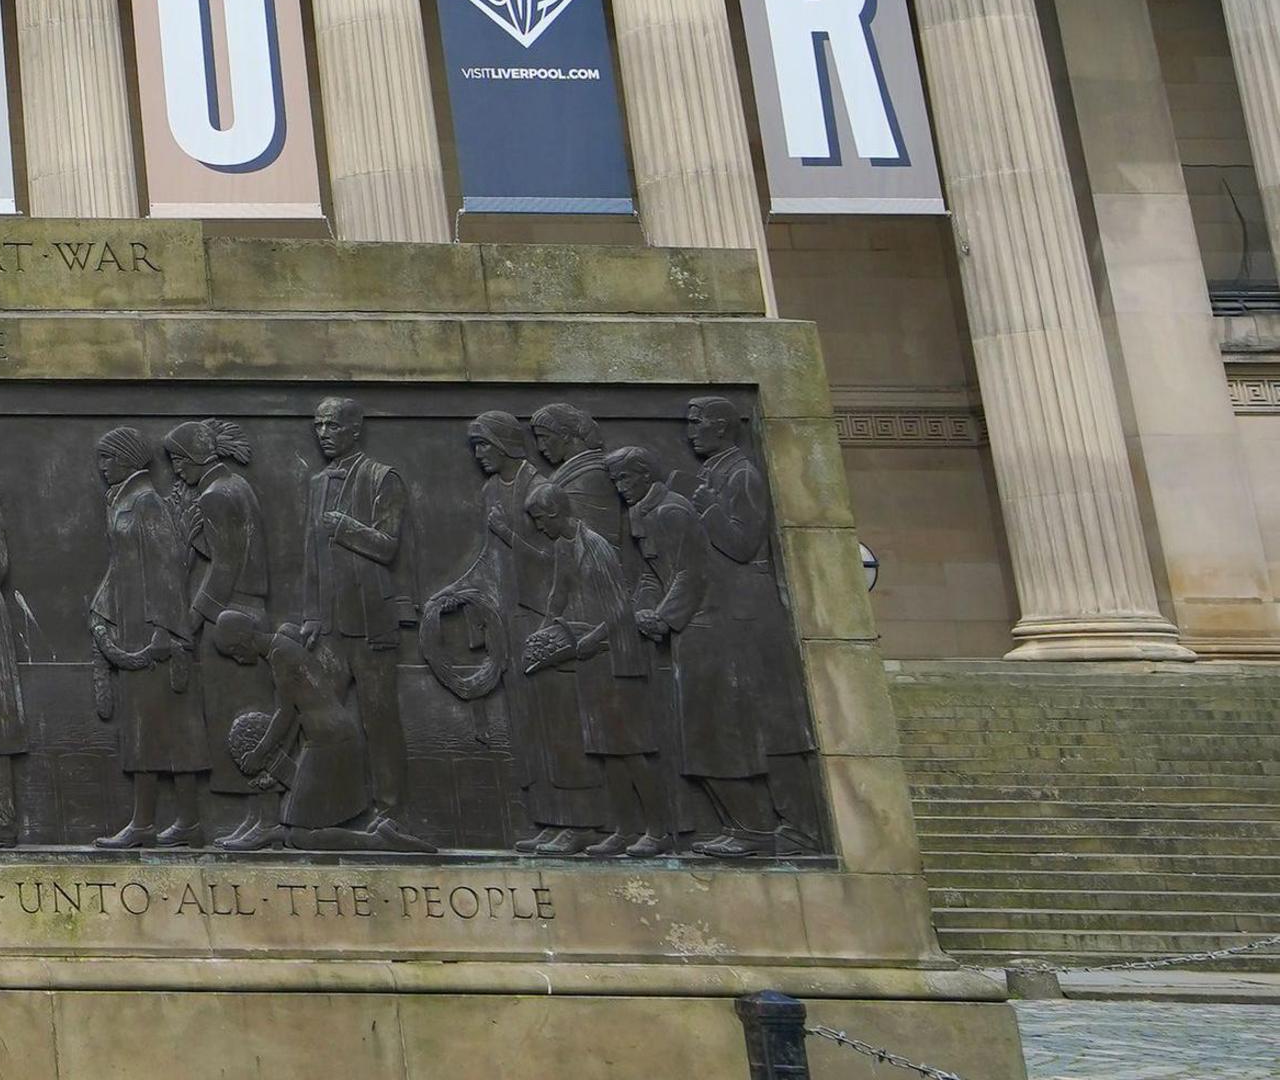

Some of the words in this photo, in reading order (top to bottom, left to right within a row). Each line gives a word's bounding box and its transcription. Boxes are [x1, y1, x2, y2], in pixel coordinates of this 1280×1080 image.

[461, 68, 600, 80] VISITLIVERPOOL.COM
[53, 242, 162, 273] WAR
[17, 881, 151, 915] UNTO
[176, 883, 256, 917] ALL
[276, 884, 372, 918] THE
[399, 885, 557, 919] PEOPLE
